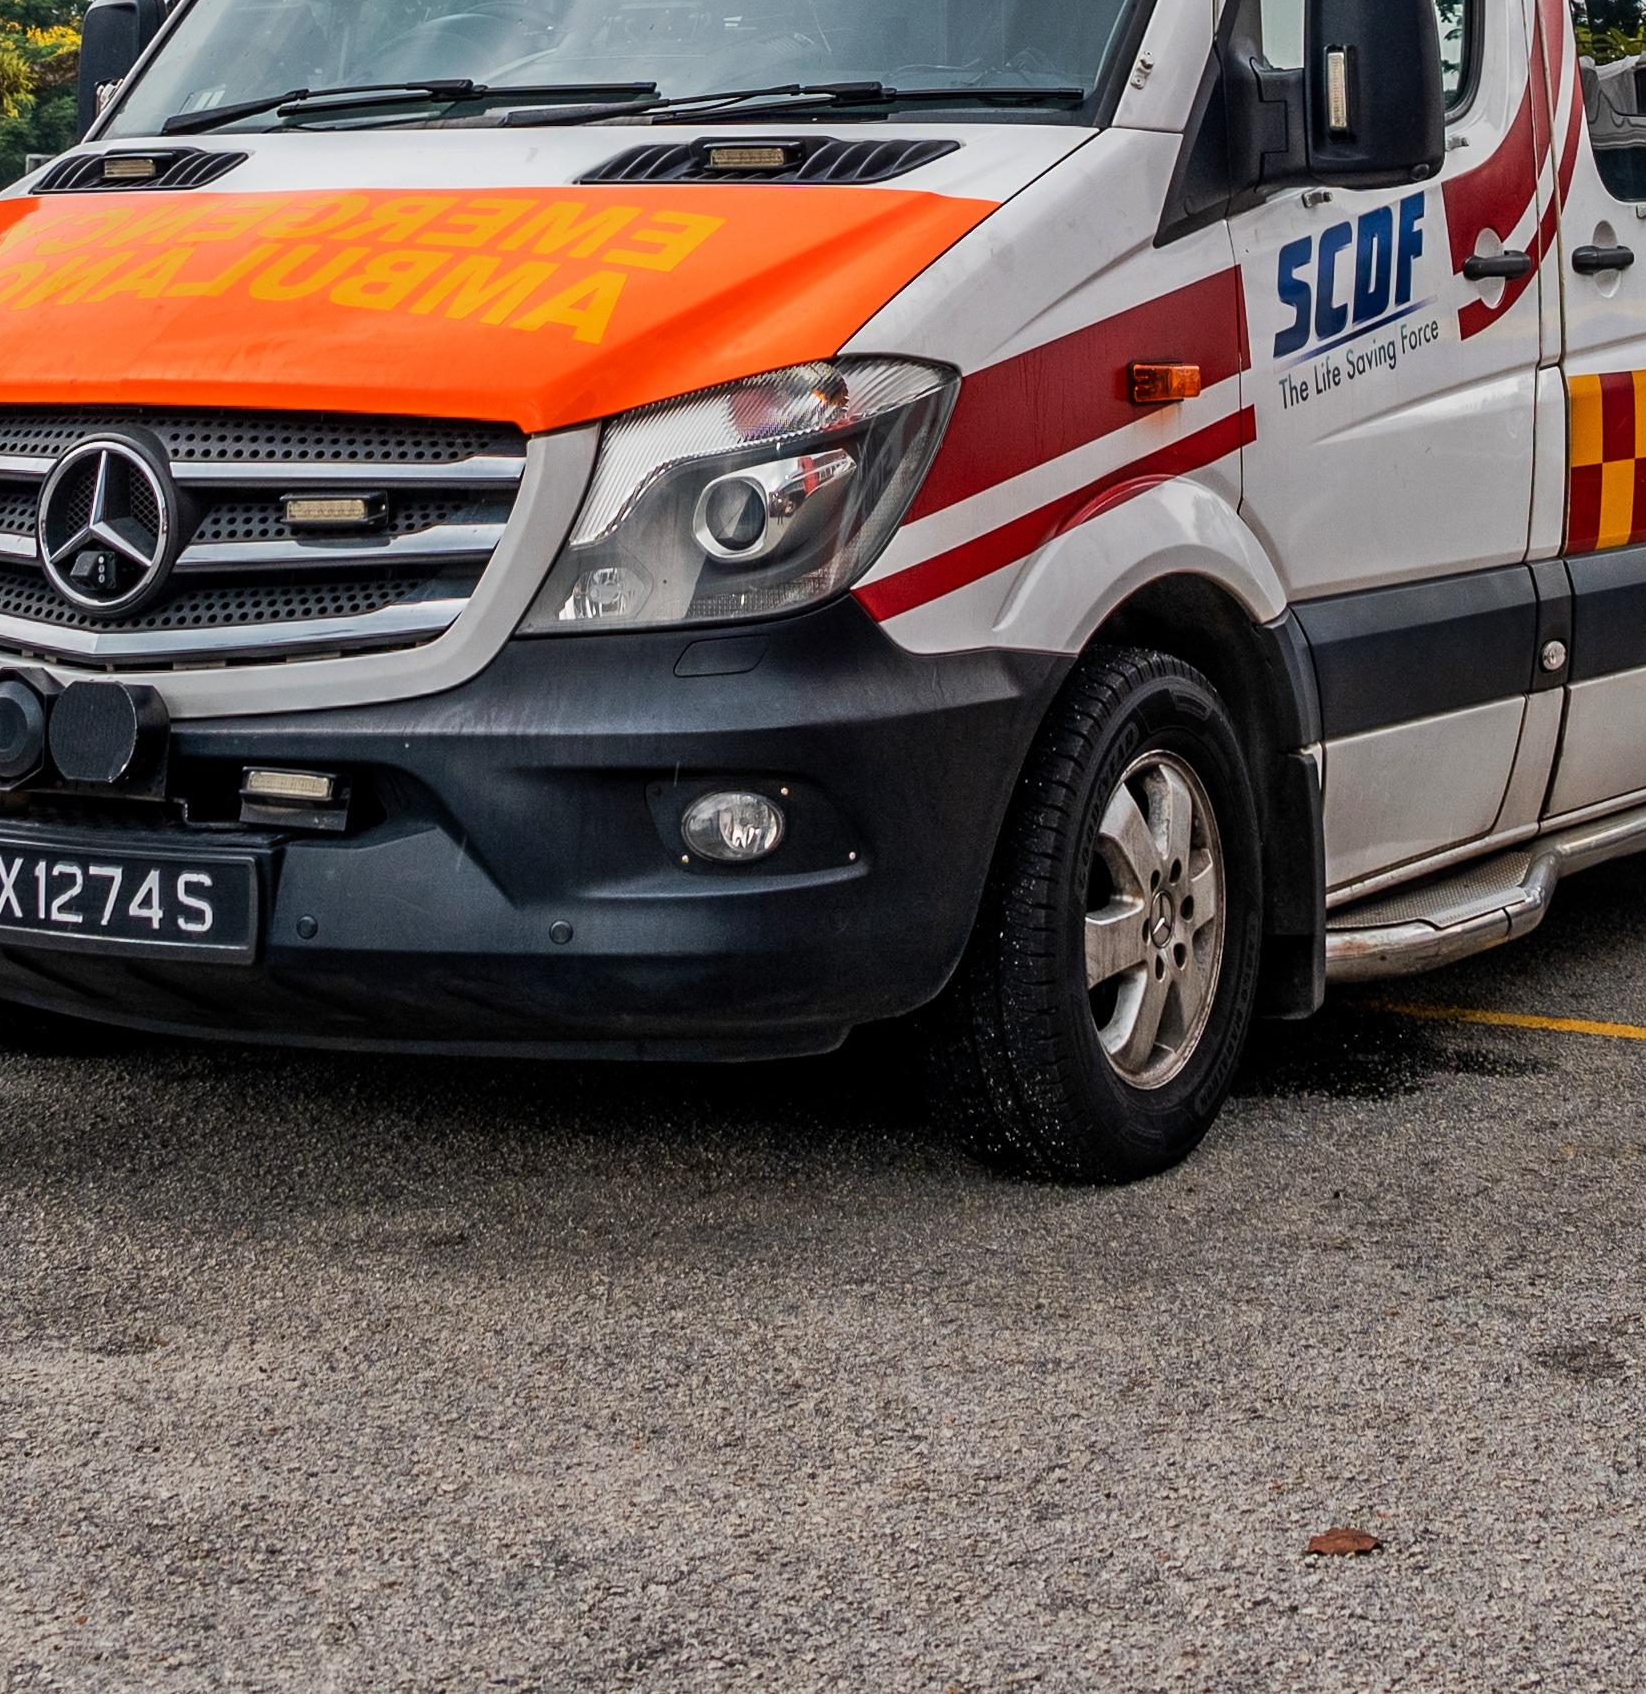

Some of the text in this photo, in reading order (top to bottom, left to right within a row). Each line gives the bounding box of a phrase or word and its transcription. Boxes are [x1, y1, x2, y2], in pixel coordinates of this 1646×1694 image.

[1273, 190, 1425, 359] SCDF
[1278, 319, 1439, 410] The Life Saving Force
